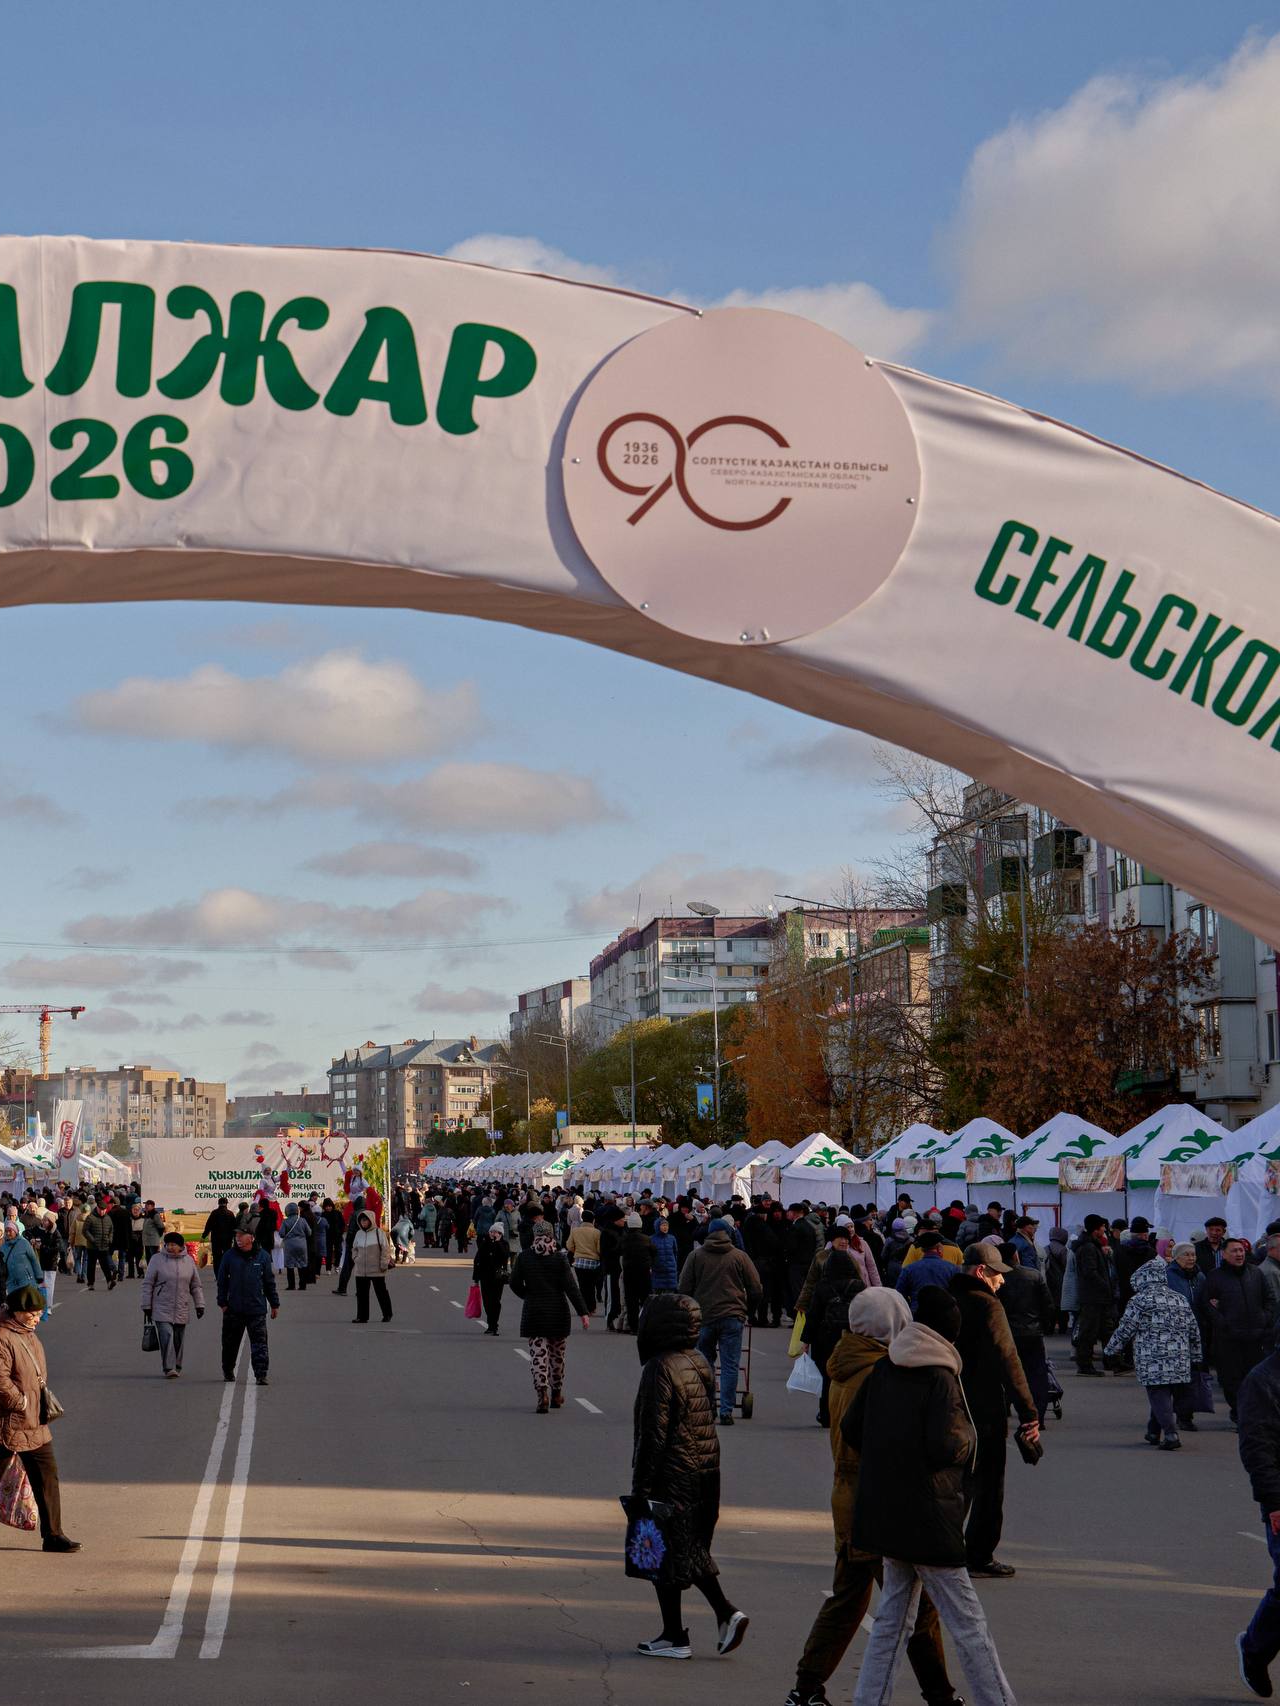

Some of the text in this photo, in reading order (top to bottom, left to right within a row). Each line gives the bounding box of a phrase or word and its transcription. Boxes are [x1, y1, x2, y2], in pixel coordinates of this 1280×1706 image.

[623, 442, 660, 454] 1936
[623, 454, 660, 465] 2026
[692, 456, 889, 472] СОЛТҮСТІК ҚАЗАҚСТАН ОБЛЫСЫ
[724, 478, 858, 491] NORTH-KAZAKHSTAN REGION
[208, 1170, 312, 1181] ҚЫЗЫЛЖР 026
